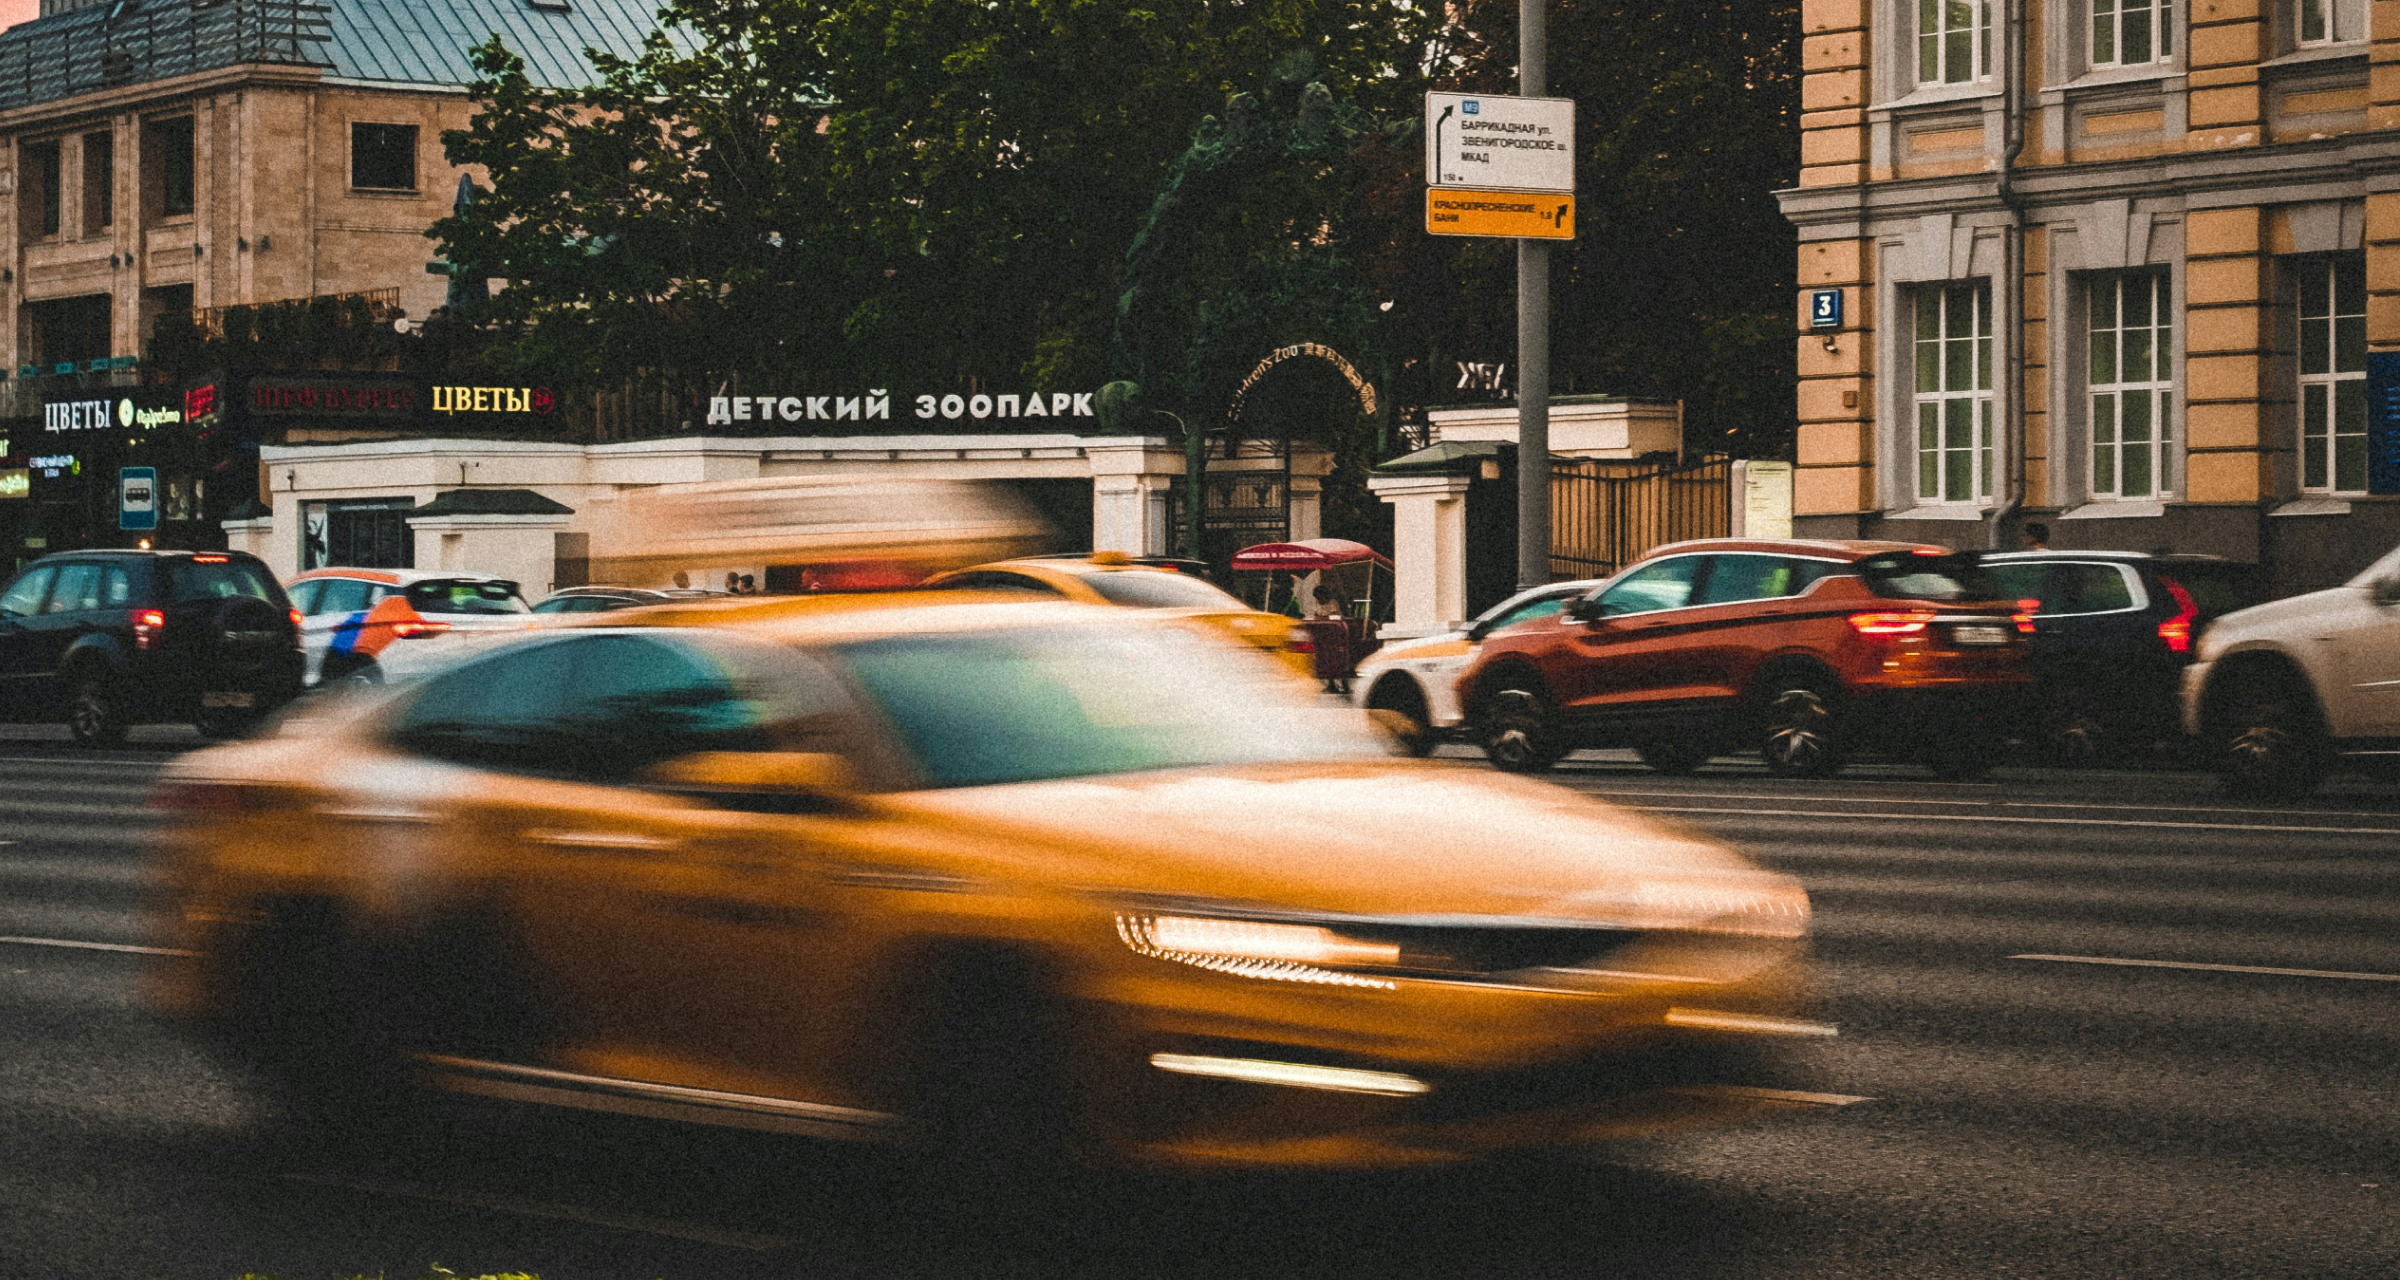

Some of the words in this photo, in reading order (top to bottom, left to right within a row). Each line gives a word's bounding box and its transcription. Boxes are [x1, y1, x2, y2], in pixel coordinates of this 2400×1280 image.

[1461, 120, 1535, 133] БАРРИКАДНАЯ
[1538, 126, 1552, 136] ул.
[1462, 136, 1555, 150] ЗВЕНИГОРОДСКОЕ
[1461, 152, 1489, 163] МКАД
[1444, 173, 1456, 181] 150
[1434, 200, 1535, 213] КРАСНОПРЕСНЕНСКИЕ
[1434, 213, 1459, 222] БАНИ
[1818, 295, 1831, 316] 3
[1273, 345, 1298, 363] Zoo
[256, 386, 318, 408] ШЕФ
[325, 387, 416, 409] БУРГЕР
[432, 386, 532, 416] ЦВЕТЫ
[535, 393, 550, 406] 24
[707, 388, 890, 425] ДЕТСКИЙ
[915, 392, 1094, 419] ЗООПАРК
[45, 400, 111, 434] ЦВЕТЫ
